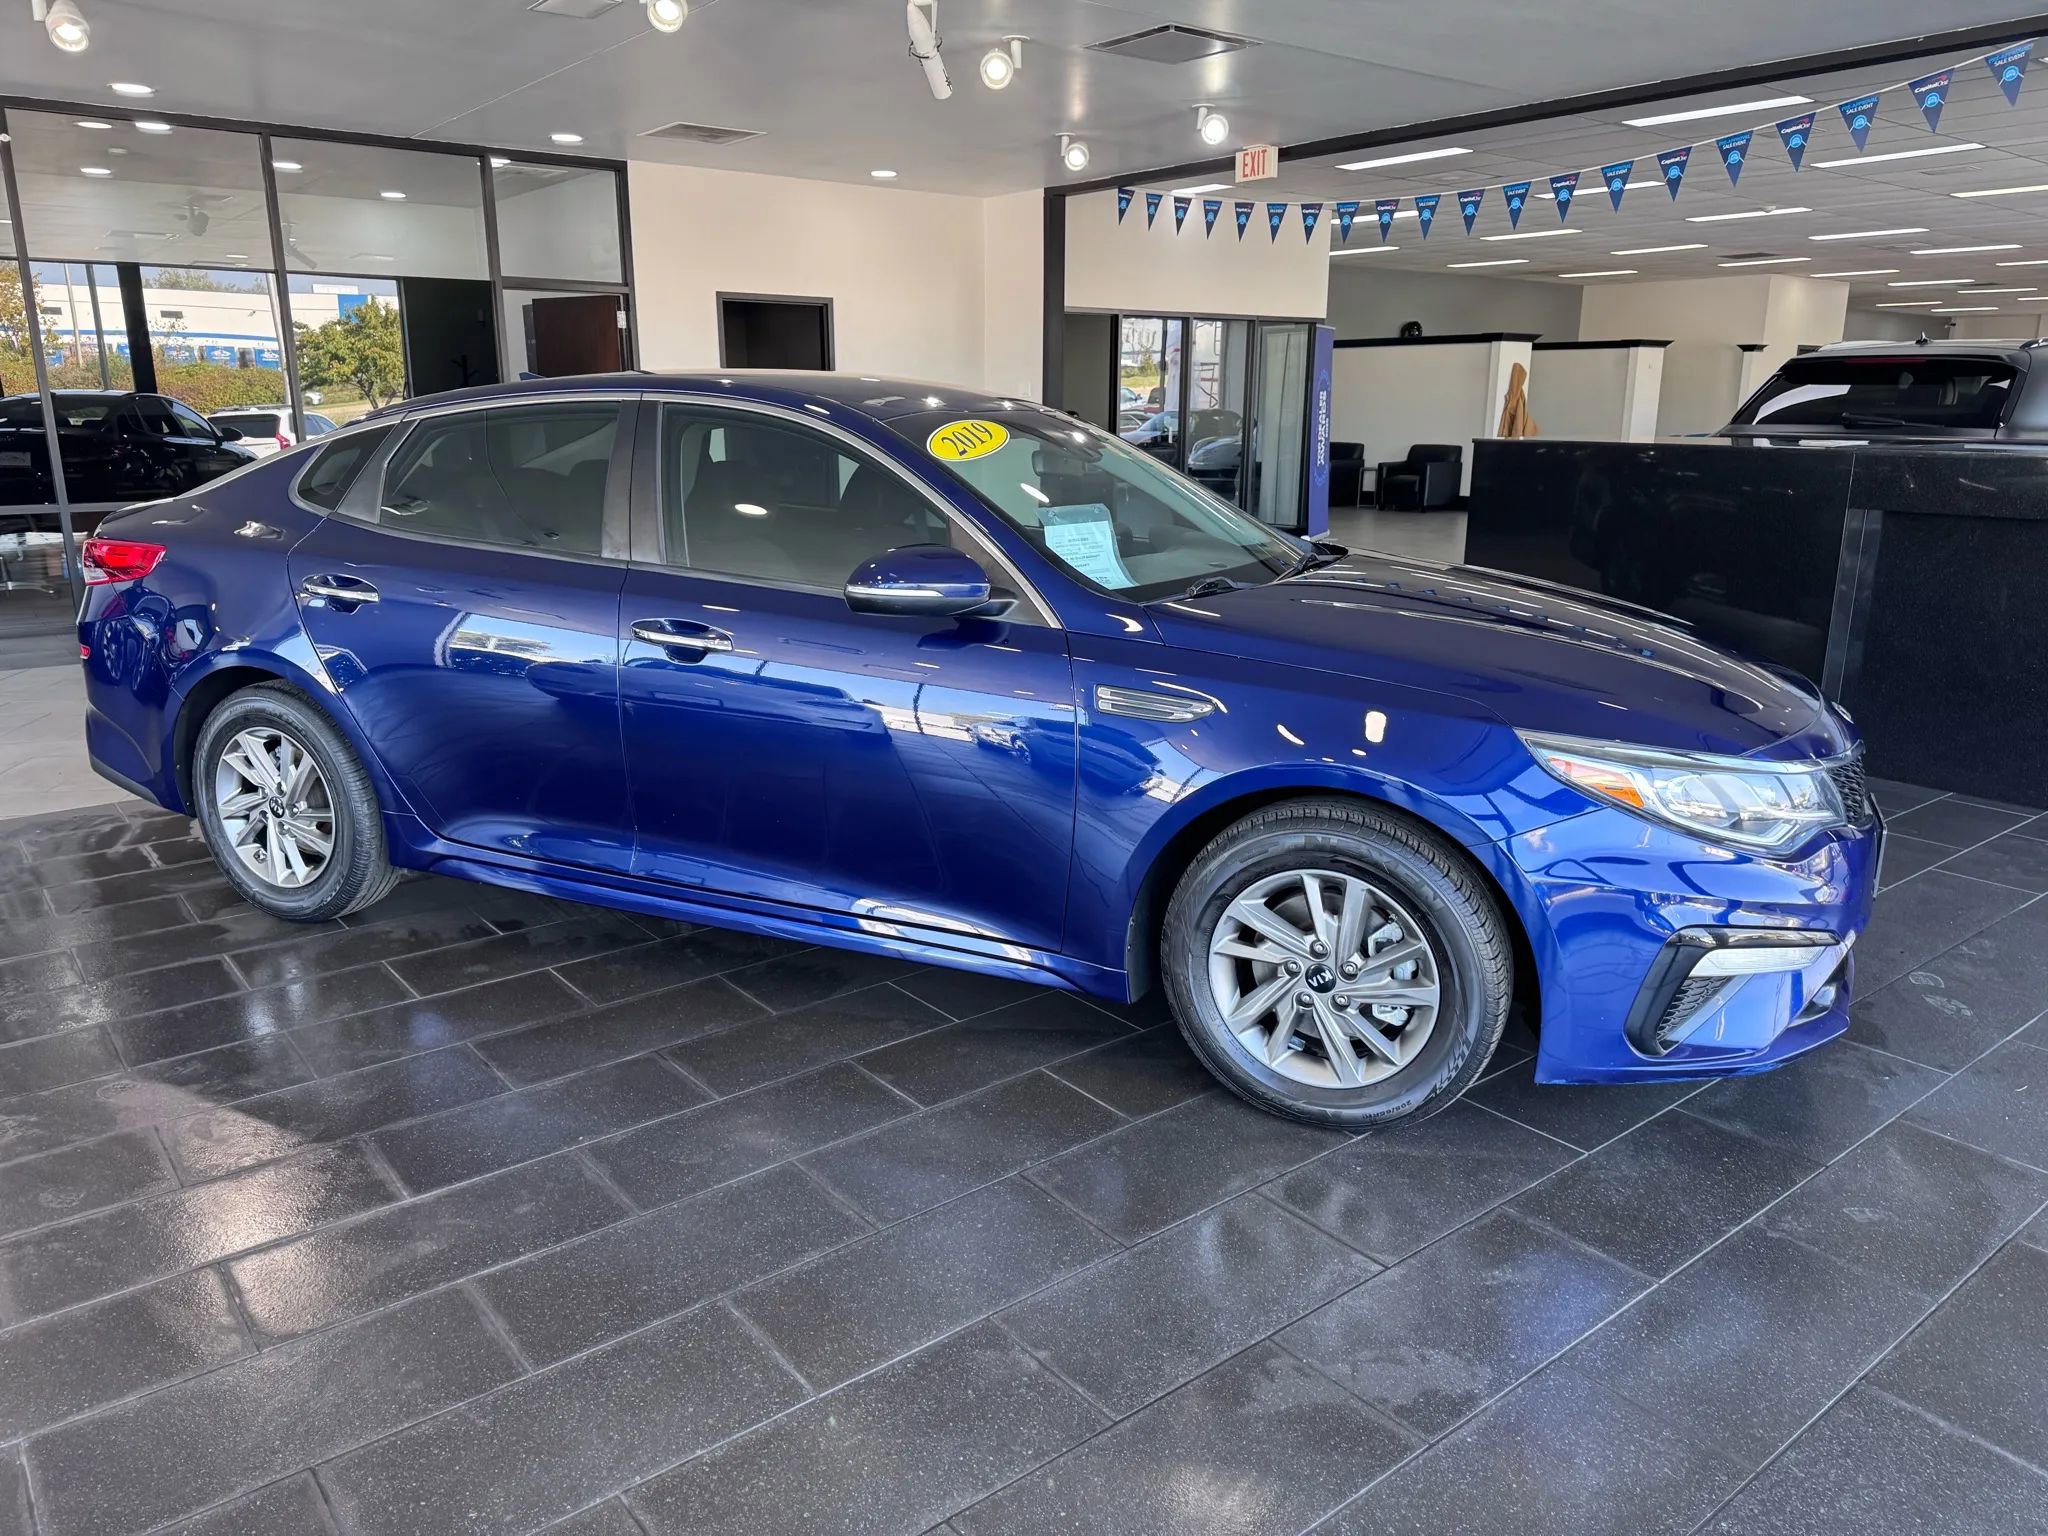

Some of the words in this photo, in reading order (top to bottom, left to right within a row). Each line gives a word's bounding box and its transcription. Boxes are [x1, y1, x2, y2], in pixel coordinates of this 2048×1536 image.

[1242, 149, 1267, 178] EXIT
[941, 422, 993, 456] 2019
[1308, 969, 1334, 987] KIA
